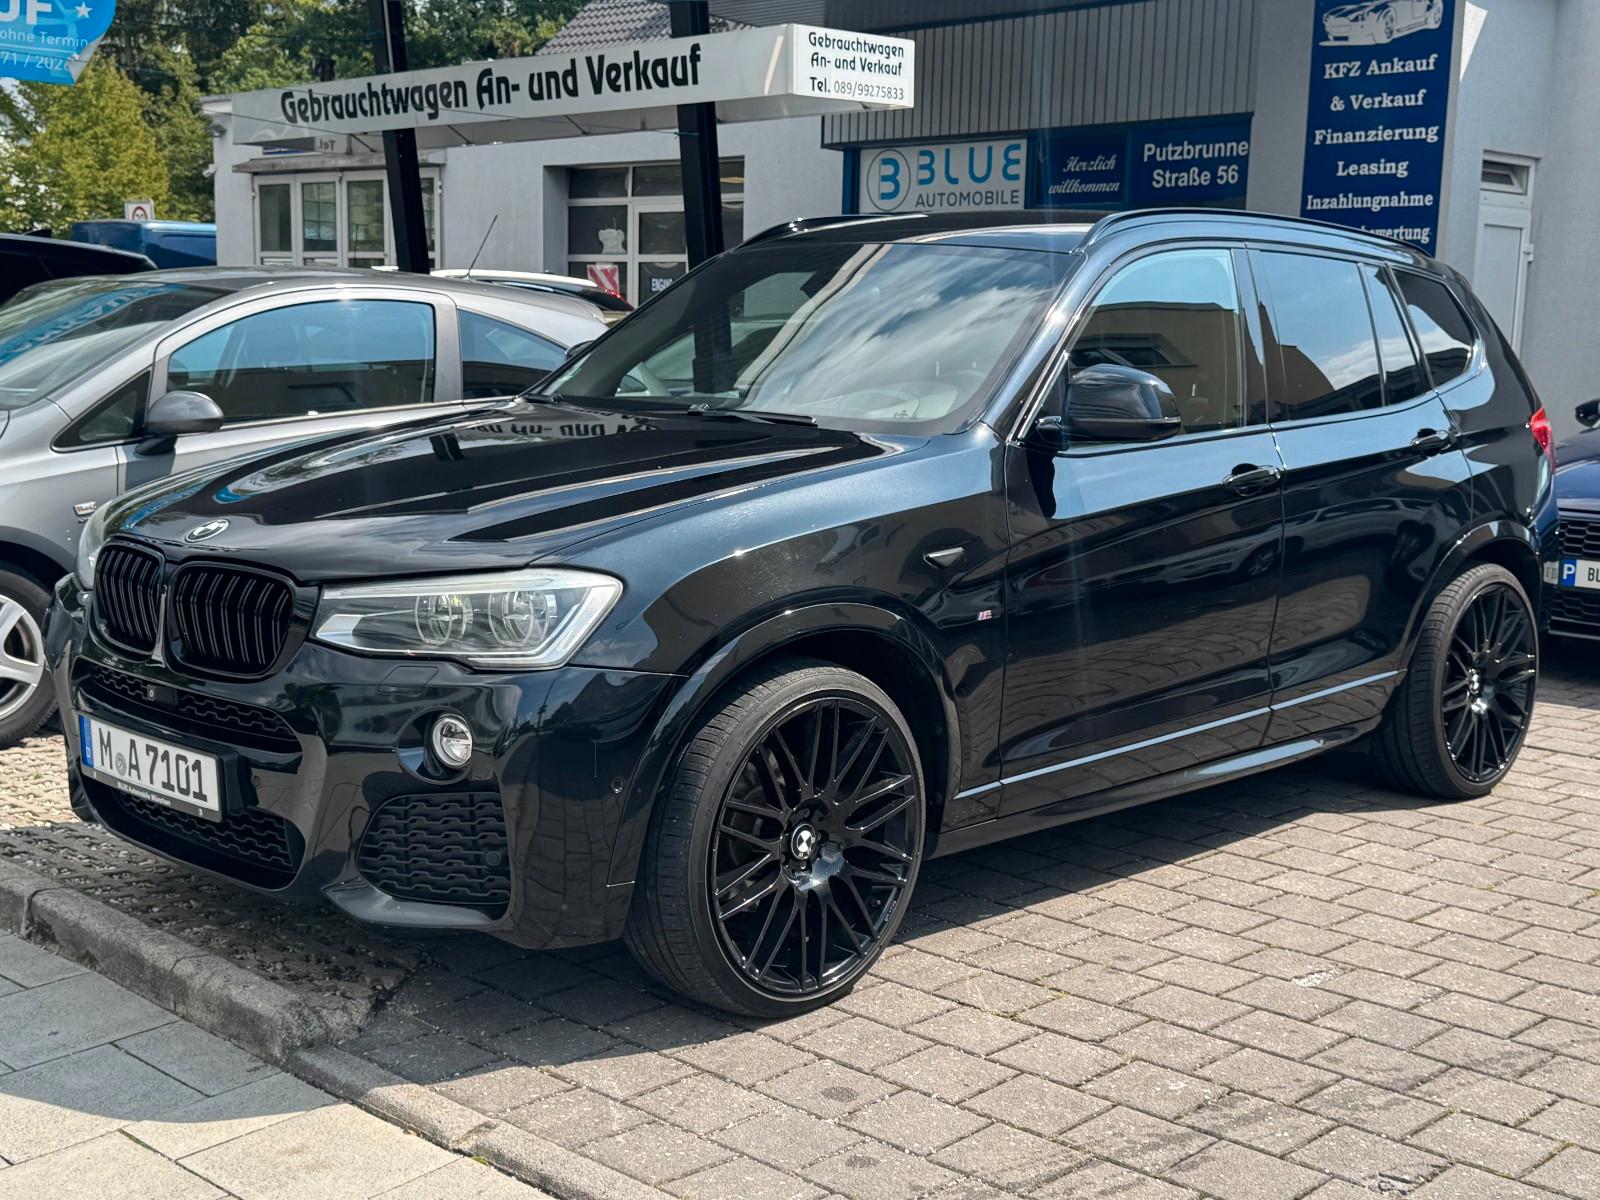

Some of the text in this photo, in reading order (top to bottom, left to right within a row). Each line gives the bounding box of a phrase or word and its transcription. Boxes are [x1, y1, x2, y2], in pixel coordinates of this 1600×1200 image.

[0, 27, 88, 48] ohne Termin
[808, 31, 904, 59] Gebrauchtwagen
[811, 52, 902, 76] An- und Verkauf
[1323, 53, 1438, 79] KFZ Ankauf
[280, 43, 701, 124] Gebrauchtwagen An- und Verkauf
[809, 76, 904, 100] Tel. 089/99275833
[1330, 89, 1427, 112] & Verkauf
[1313, 125, 1440, 145] Finanzierung
[1143, 140, 1249, 162] Putzbrunne
[917, 144, 1021, 185] BLUE
[1062, 154, 1118, 172] Herzlich
[1336, 158, 1409, 178] Leasing
[1048, 178, 1120, 194] willkommen
[1152, 164, 1239, 188] Straße 56
[915, 189, 1020, 208] AUTOMOBILE
[1306, 190, 1434, 212] Inzahlungnahme
[1361, 225, 1431, 244] wertung
